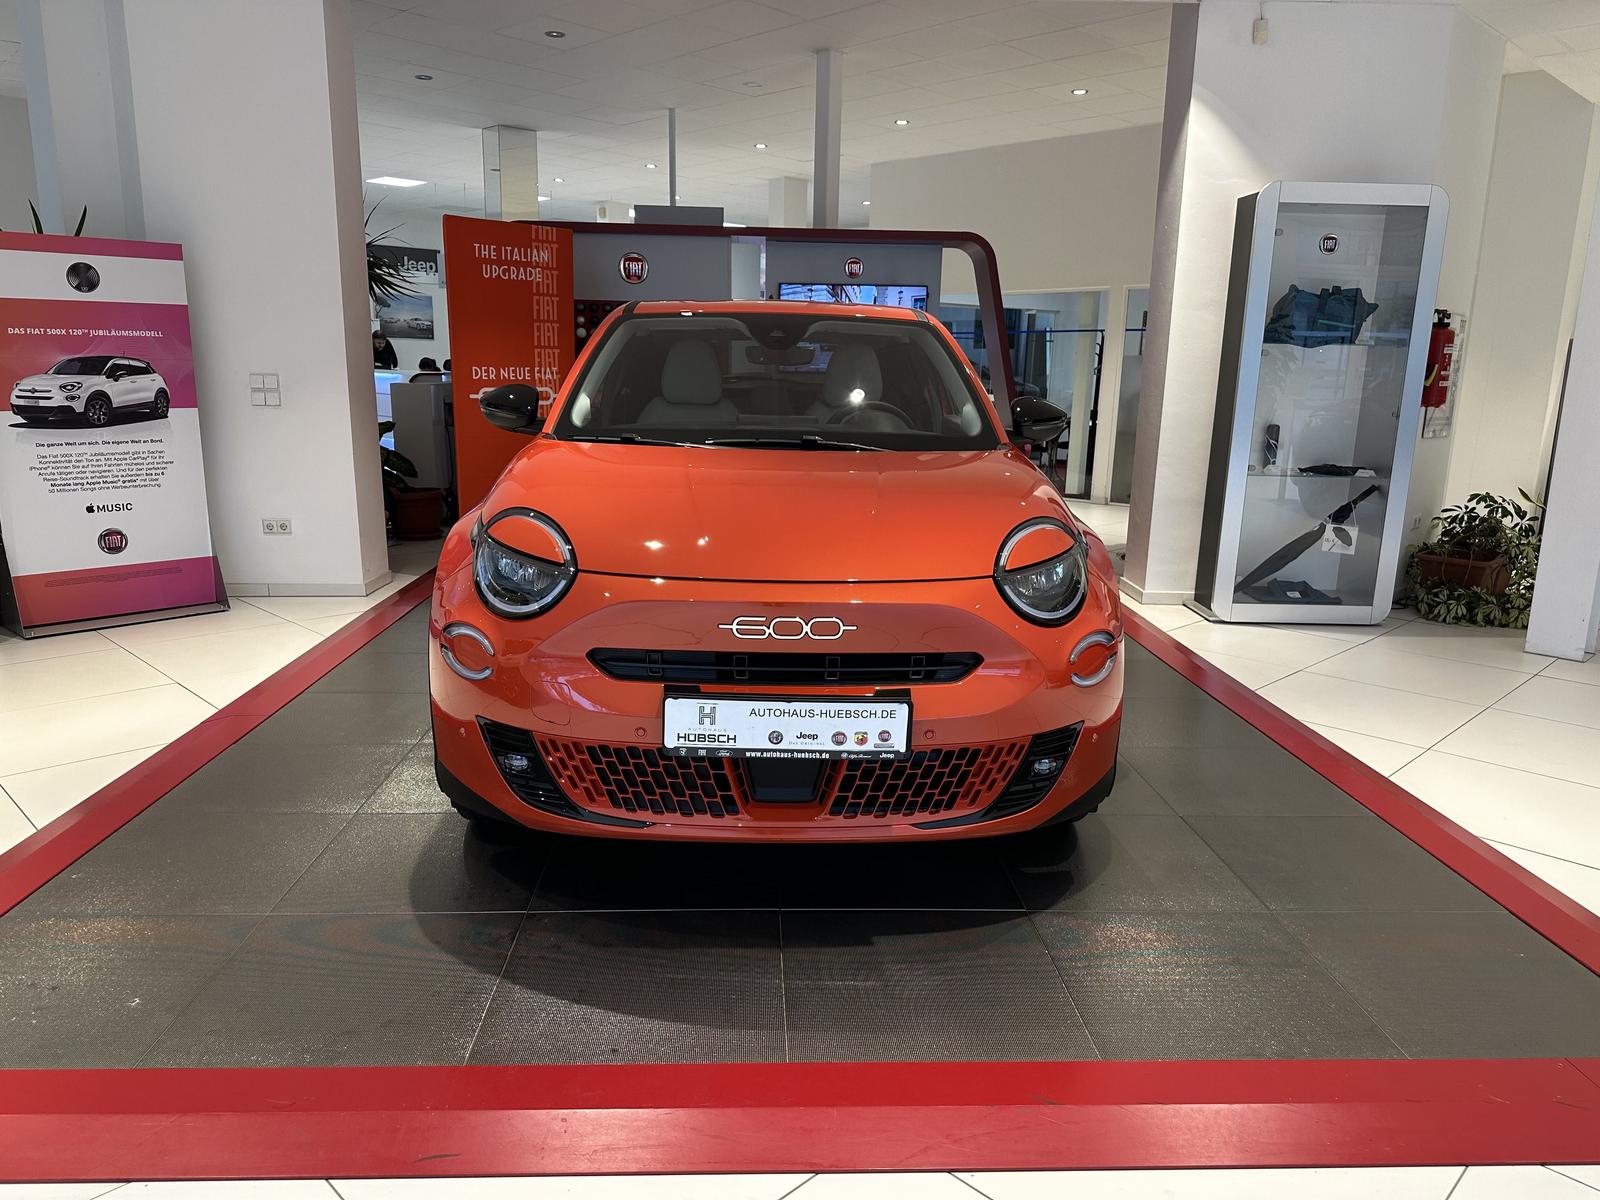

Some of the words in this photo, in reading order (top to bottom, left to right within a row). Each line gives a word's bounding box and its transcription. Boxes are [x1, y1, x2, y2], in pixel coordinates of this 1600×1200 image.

[473, 243, 497, 259] THE
[501, 246, 549, 262] ITALIAN
[398, 255, 437, 276] Jeep
[625, 261, 643, 276] FIAT
[482, 264, 542, 281] UPGRADE
[533, 296, 560, 321] FIAT
[27, 327, 45, 335] FIAT
[89, 328, 164, 338] JUBILÄUMSMODELL
[534, 322, 560, 347] FIAT
[472, 366, 496, 380] DER
[500, 367, 531, 380] NEUE
[534, 367, 558, 380] FIAT
[96, 502, 134, 513] MUSIC
[105, 535, 122, 548] FIAT
[730, 615, 846, 641] 600
[749, 707, 897, 720] AUTOHAUS-HUEBSCH.DE
[676, 732, 737, 744] HÜBSCH
[795, 731, 819, 741] Jeep
[745, 751, 830, 760] www.autohaus-huebsch.de
[879, 752, 895, 760] Jeep
